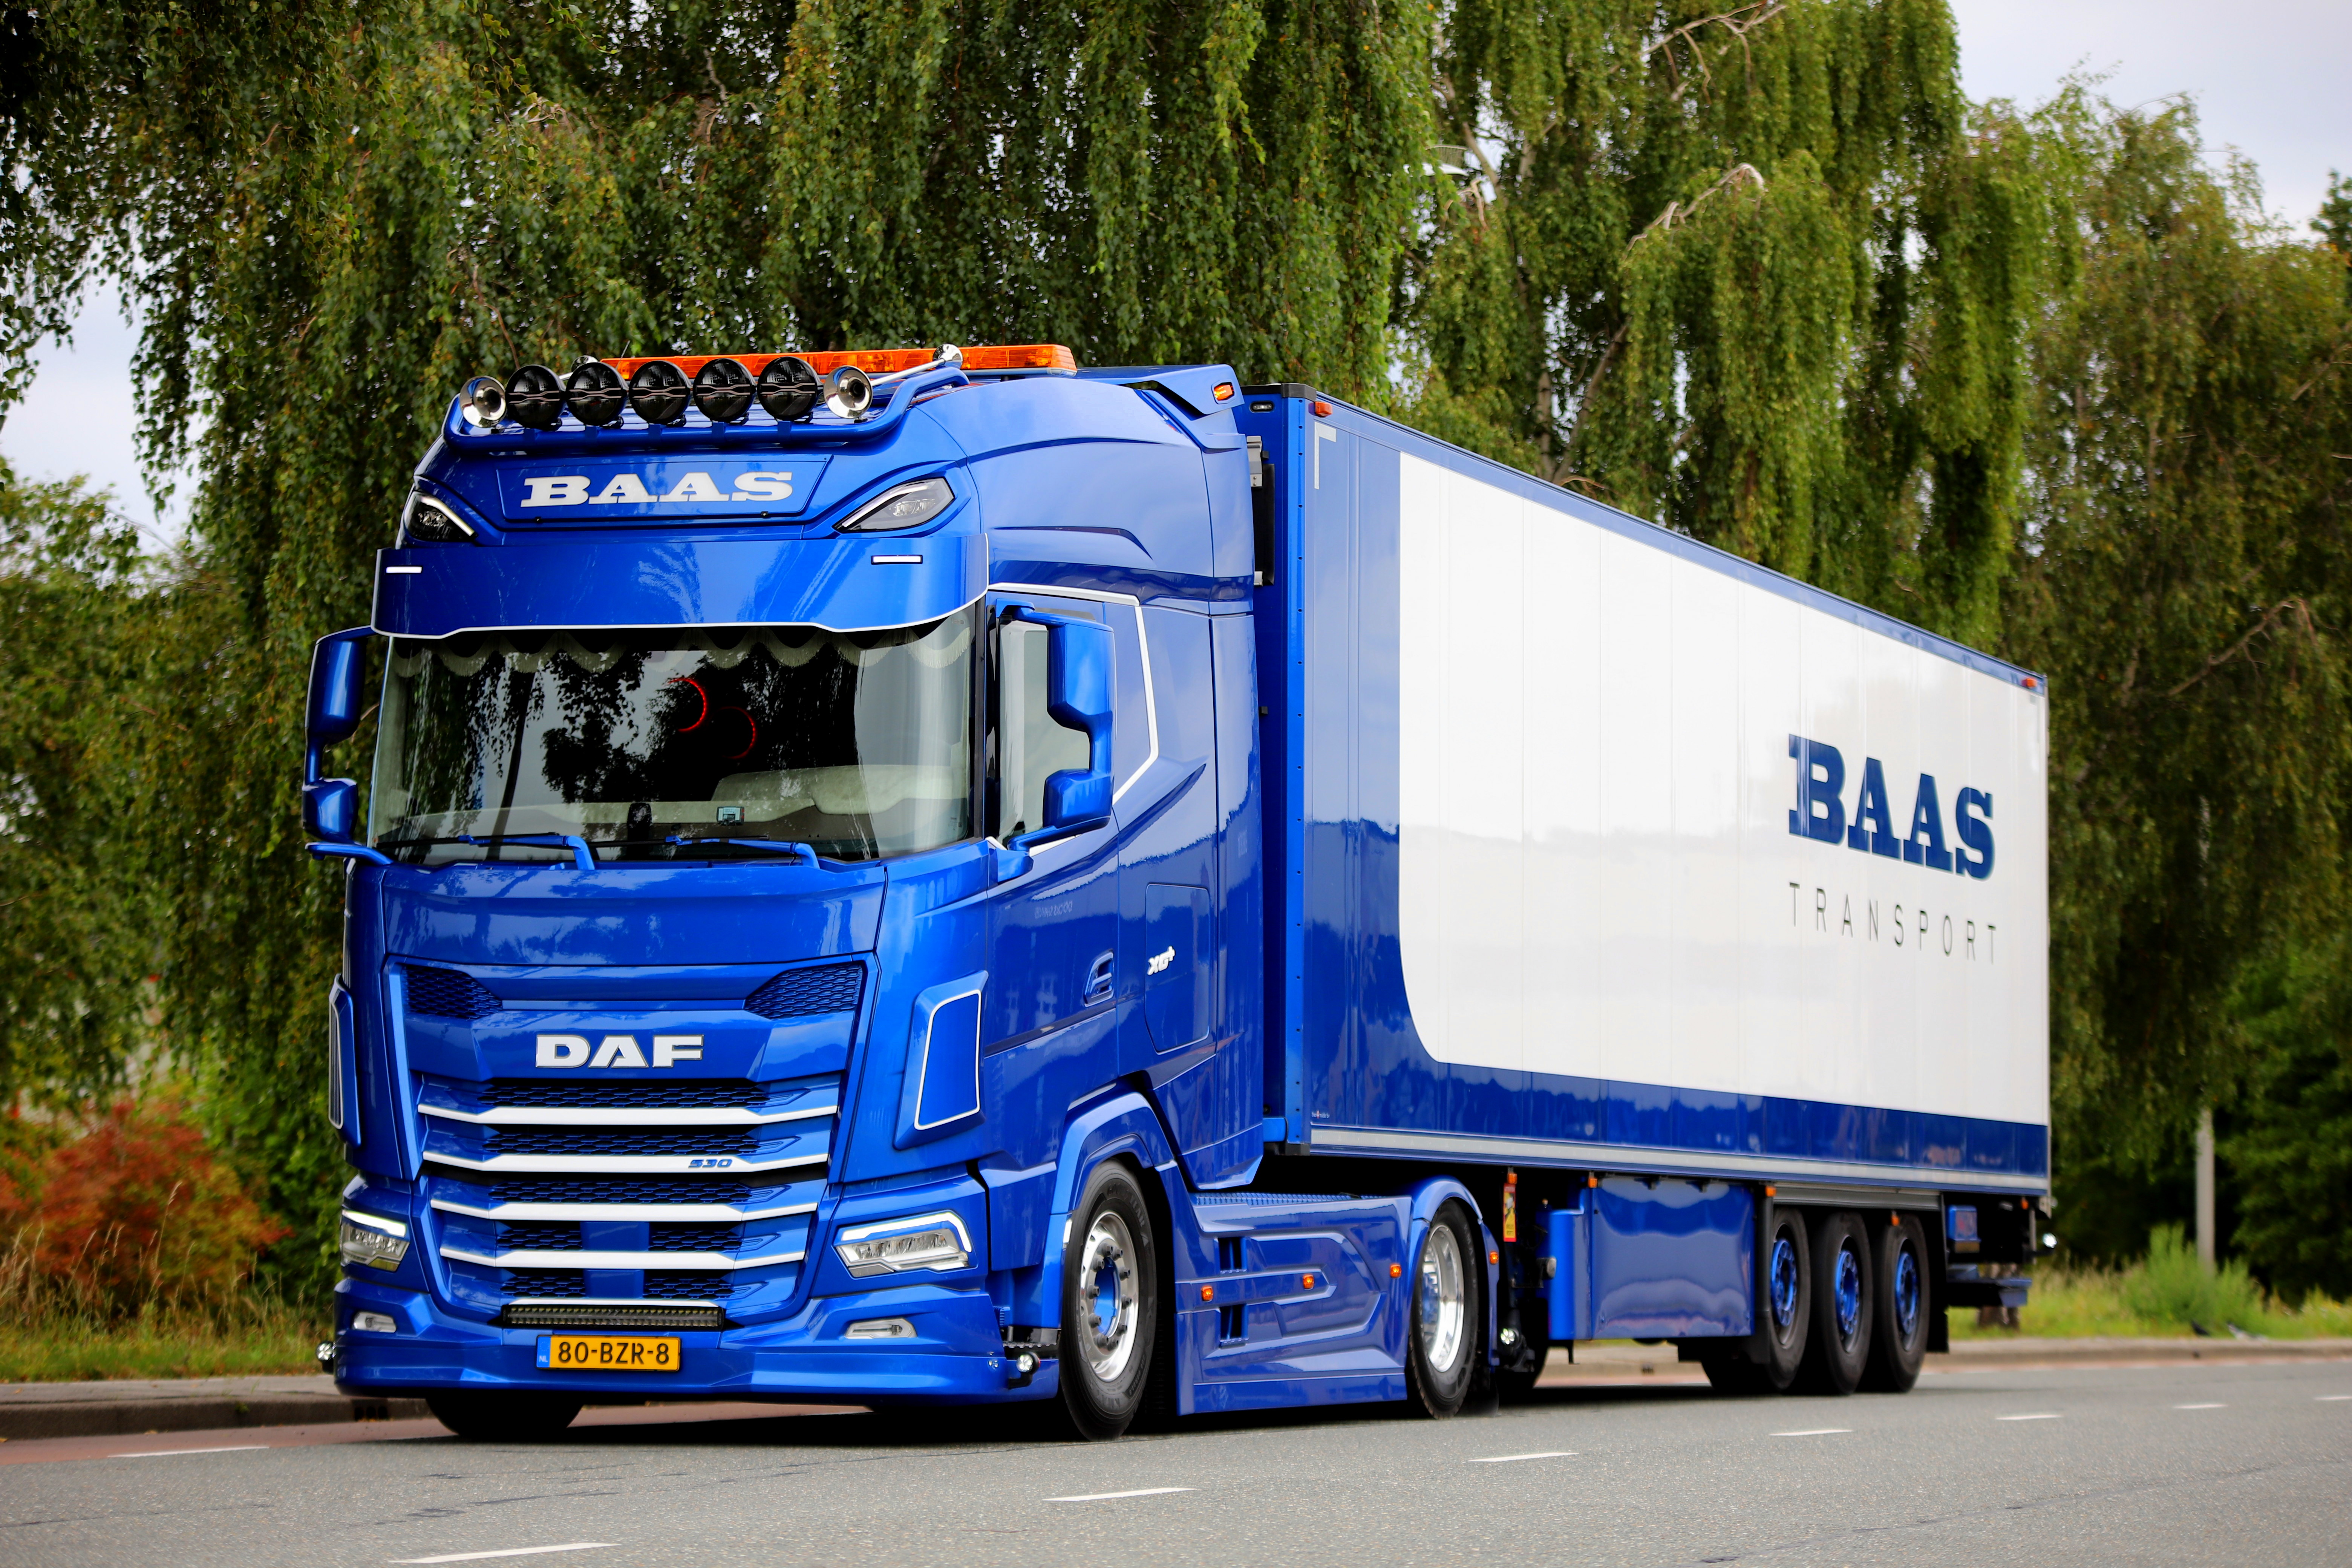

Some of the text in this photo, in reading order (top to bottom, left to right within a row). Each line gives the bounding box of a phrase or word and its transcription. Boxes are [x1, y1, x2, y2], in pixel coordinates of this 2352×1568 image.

[521, 472, 793, 507] BAAS
[1788, 733, 1995, 882] BAAS
[1789, 882, 1997, 965] TRANSPORT
[536, 1034, 704, 1068] DAF
[688, 1159, 732, 1168] 530
[558, 1341, 670, 1365] 80-BZR-8
